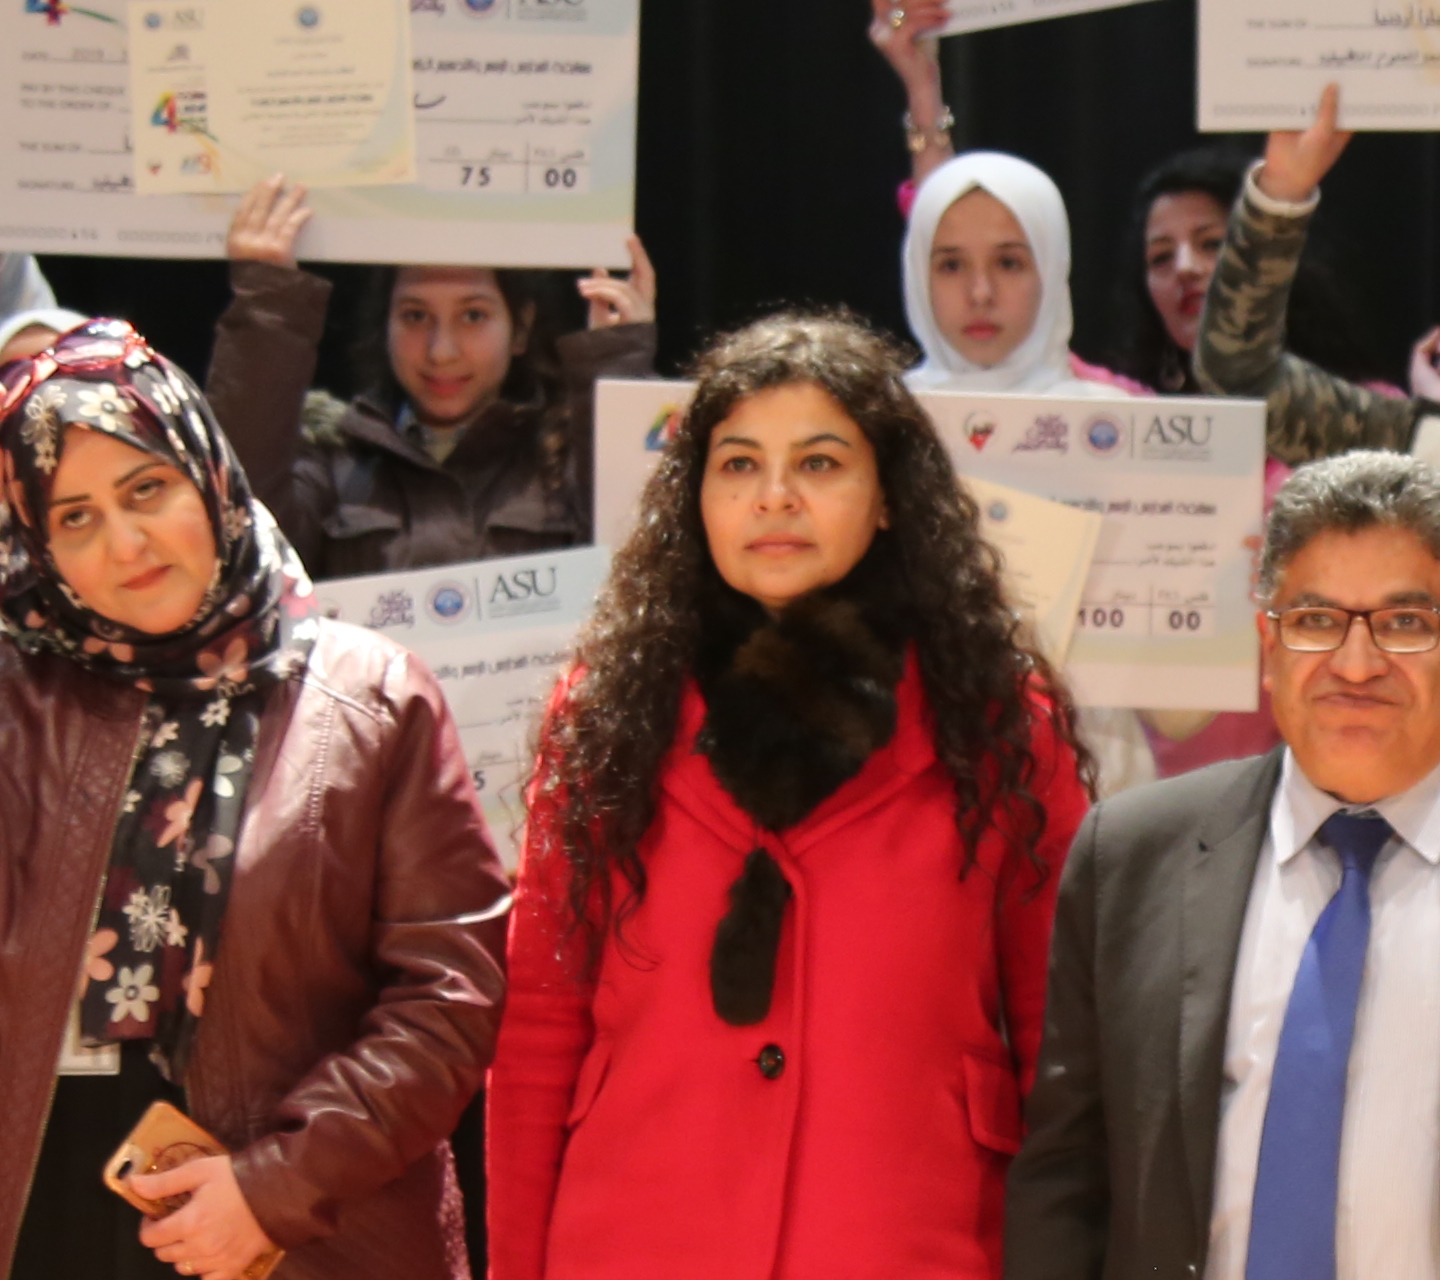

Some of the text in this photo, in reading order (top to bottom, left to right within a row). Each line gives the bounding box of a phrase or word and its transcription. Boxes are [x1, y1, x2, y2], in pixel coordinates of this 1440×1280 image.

[151, 91, 178, 133] 4
[462, 166, 577, 187] 75 00
[1144, 414, 1212, 445] ASU
[490, 567, 557, 603] ASU
[1078, 609, 1201, 630] 100 00
